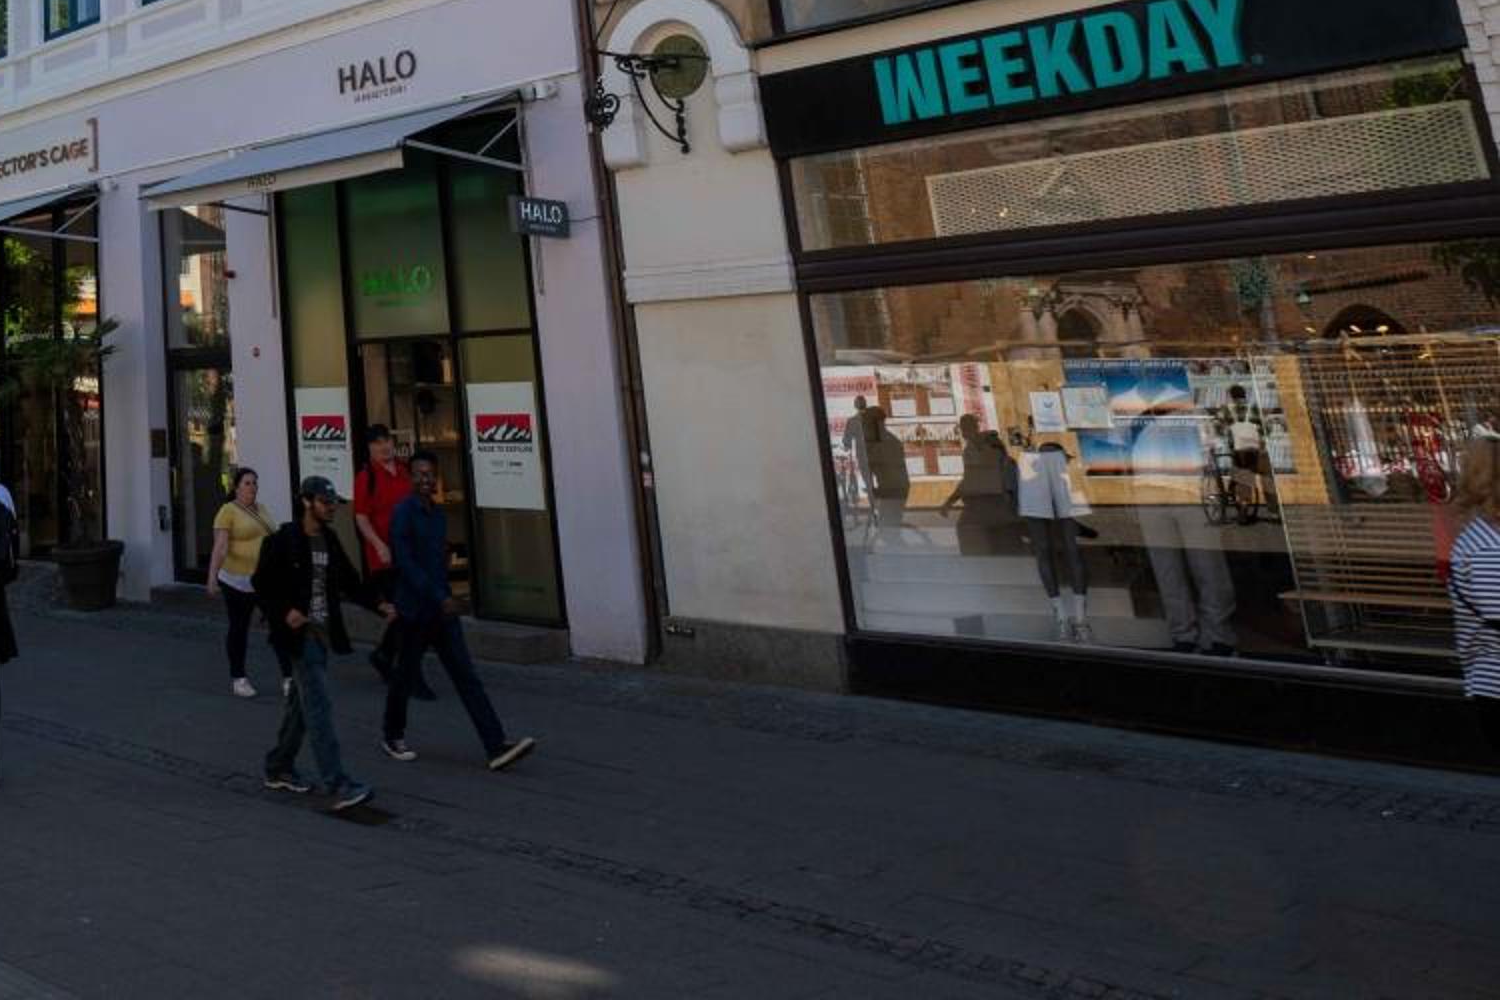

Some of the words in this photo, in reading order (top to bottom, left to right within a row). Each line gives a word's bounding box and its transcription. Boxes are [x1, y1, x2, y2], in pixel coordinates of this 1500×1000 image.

[338, 50, 417, 94] HALO
[51, 137, 89, 165] CAGE
[521, 201, 562, 225] HALO
